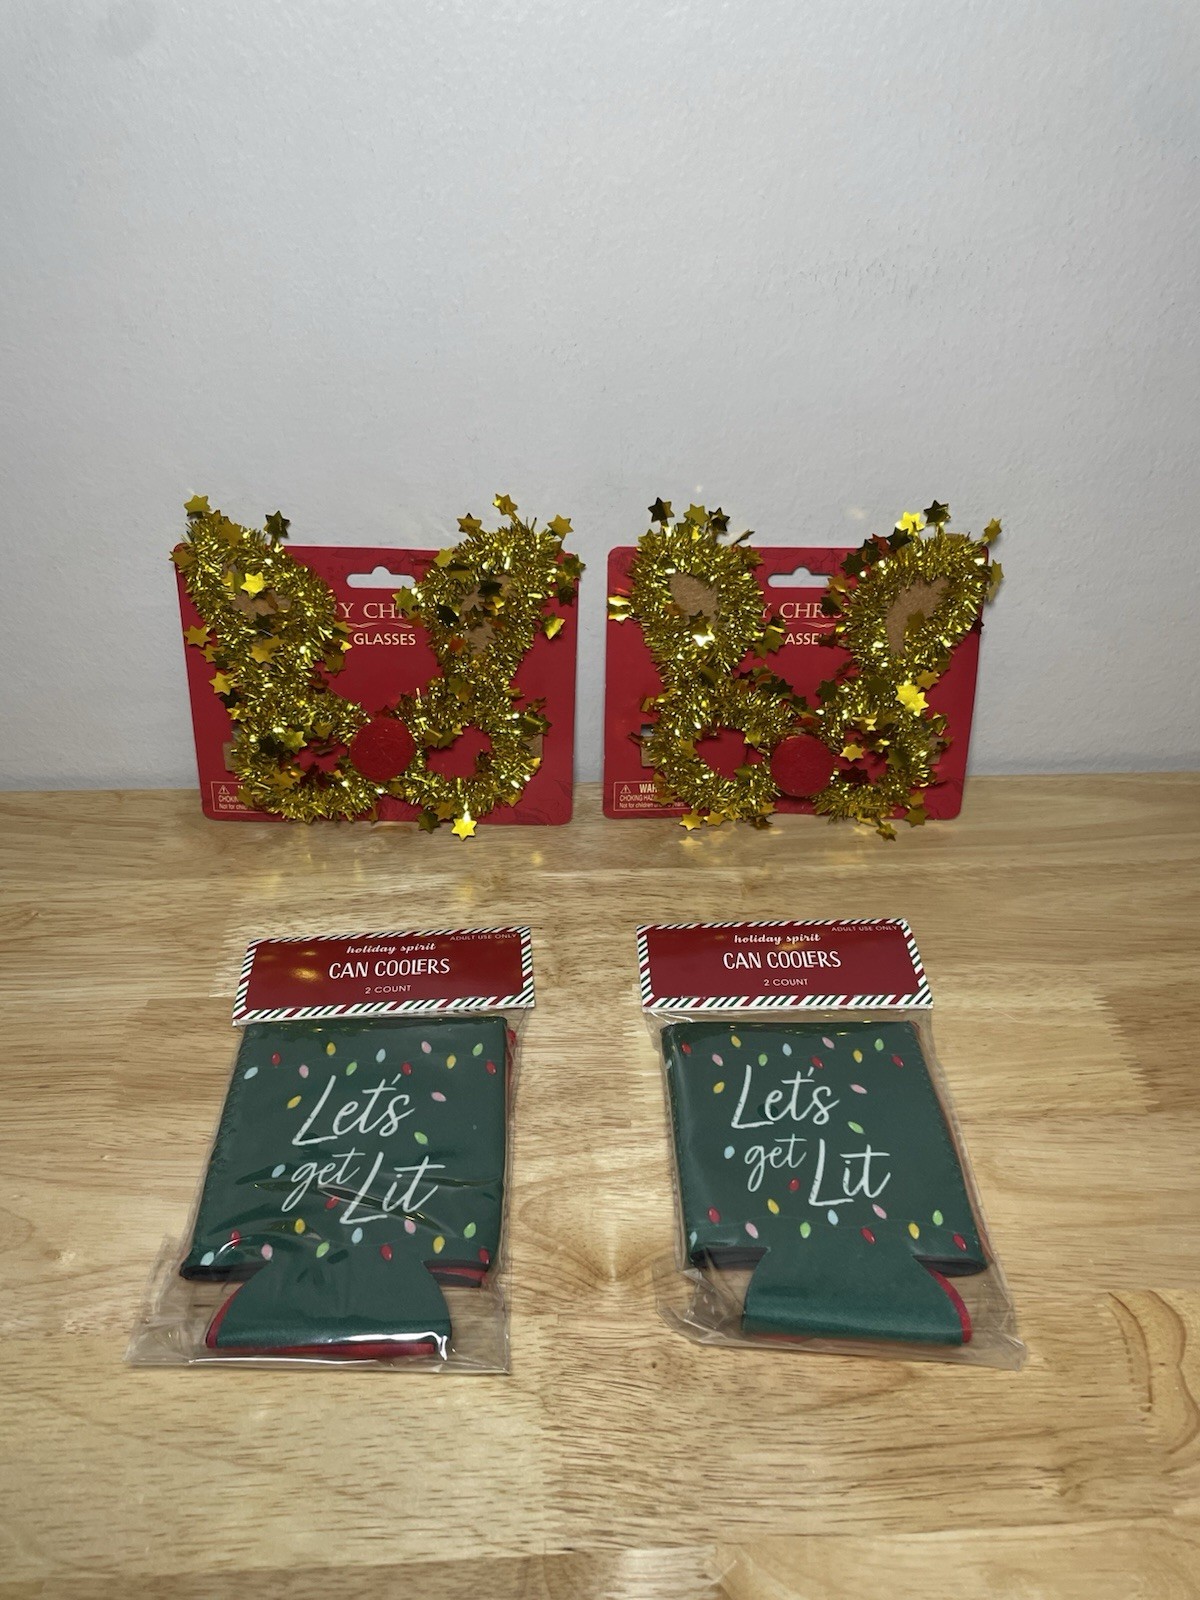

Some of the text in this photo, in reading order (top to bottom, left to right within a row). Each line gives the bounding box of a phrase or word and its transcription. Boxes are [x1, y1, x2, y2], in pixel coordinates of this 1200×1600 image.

[353, 633, 416, 646] GLASSES
[346, 942, 437, 955] holiday spirit
[734, 933, 821, 945] holiday spirit
[329, 958, 451, 979] CAN COOLERS
[723, 950, 842, 970] CAN COOLERS
[374, 985, 412, 994] COUNT
[772, 978, 808, 986] COUNT
[731, 1064, 840, 1129] Let's
[291, 1072, 415, 1146] Let's
[744, 1133, 892, 1207] get Lit
[280, 1147, 446, 1225] get Lit
